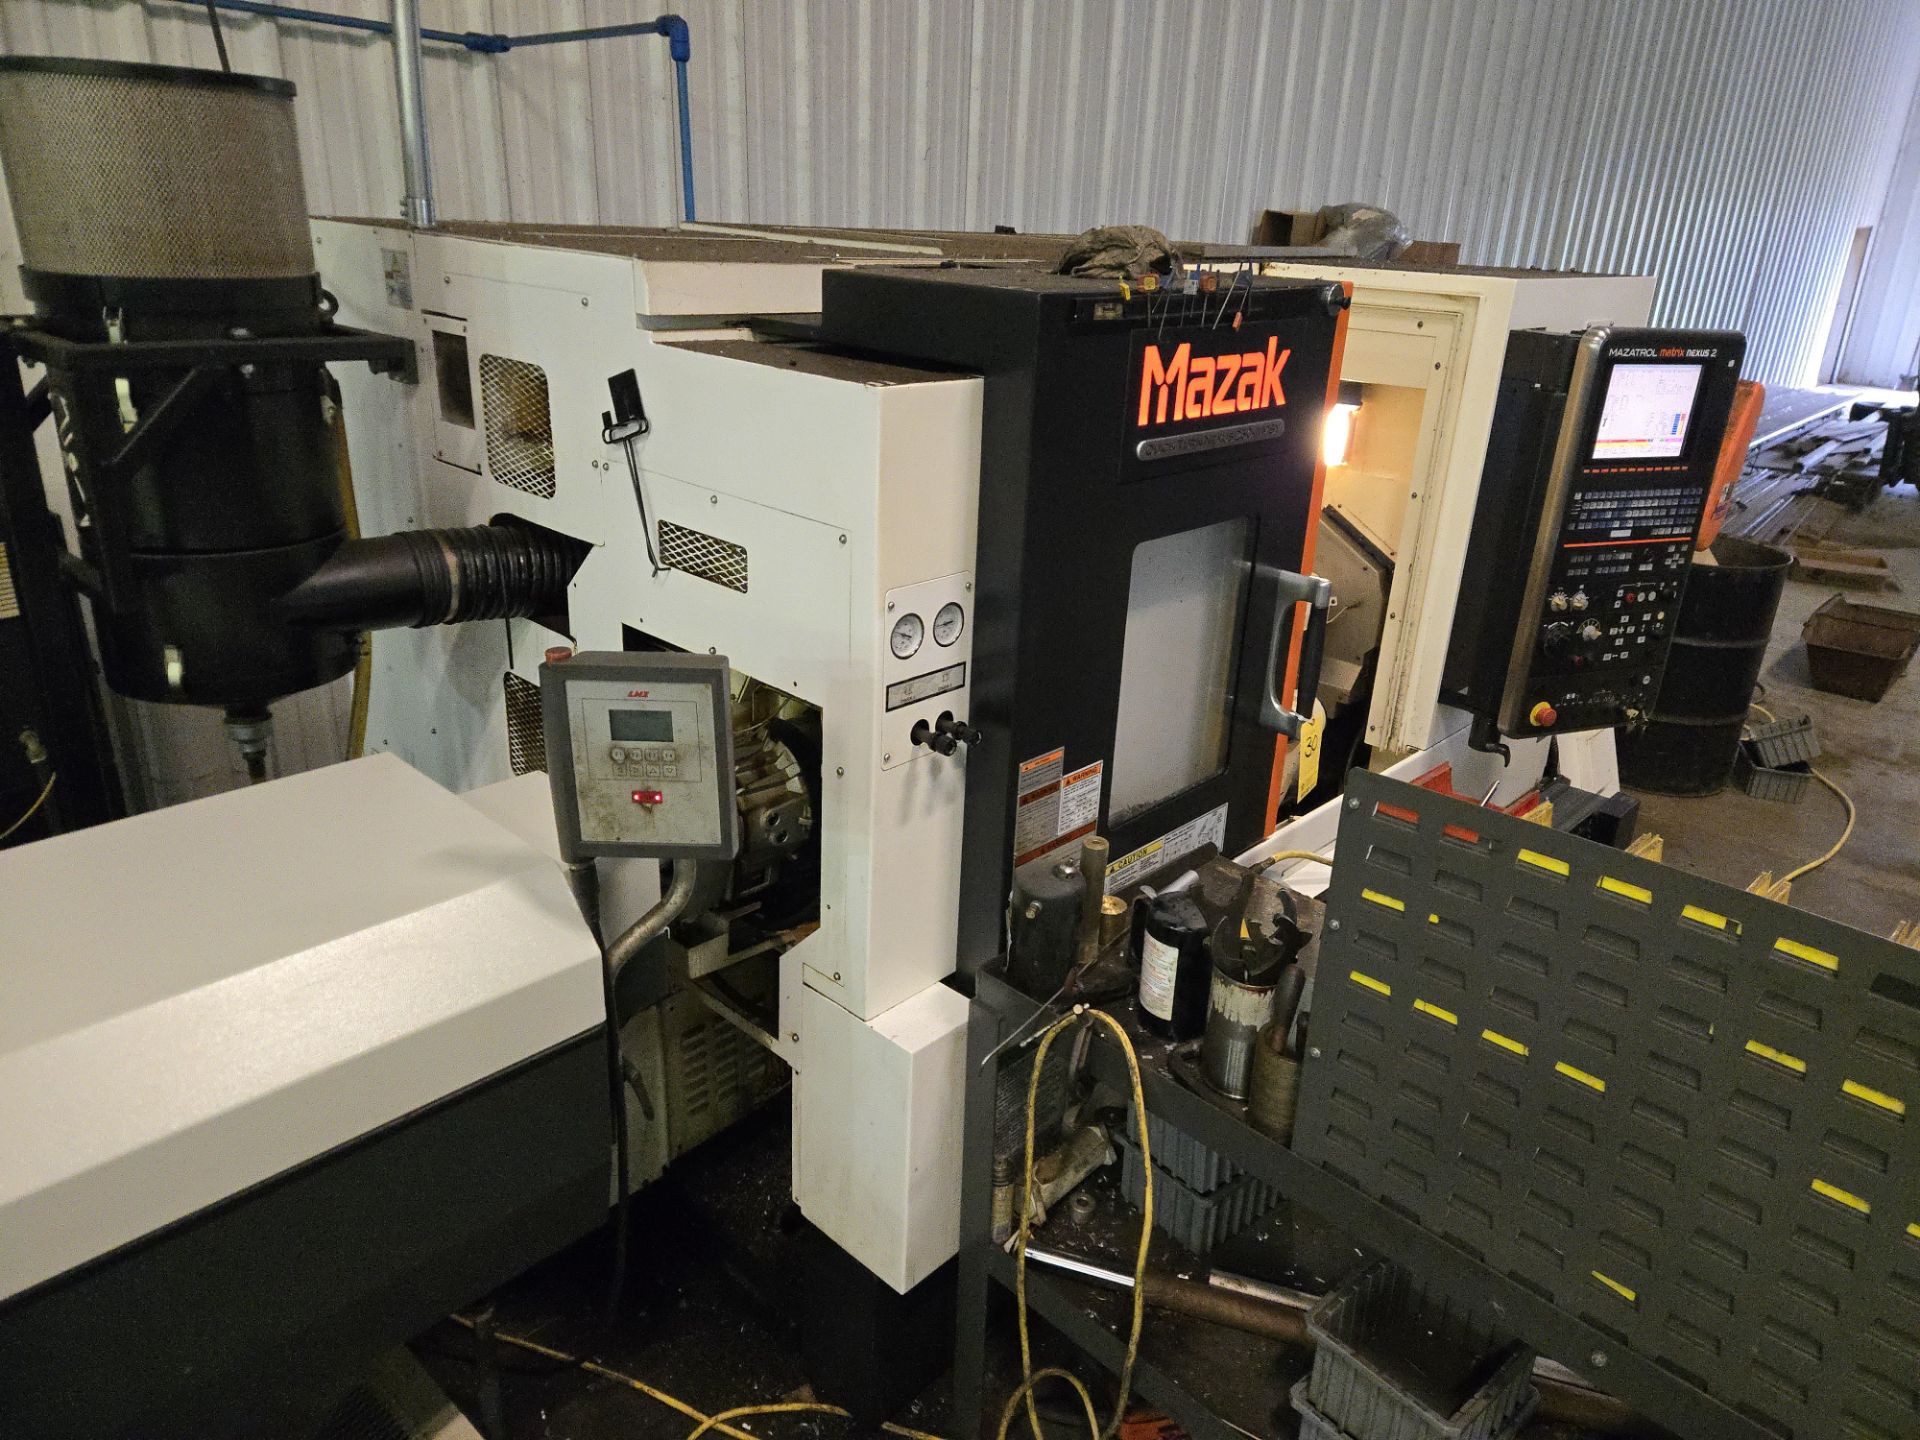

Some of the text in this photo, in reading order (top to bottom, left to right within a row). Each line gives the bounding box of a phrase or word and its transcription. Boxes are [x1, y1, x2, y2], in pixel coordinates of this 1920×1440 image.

[1608, 347, 1658, 358] MAZATROL
[1660, 347, 1685, 358] matrix
[1710, 348, 1718, 357] 2
[1137, 335, 1291, 428] Mazak
[1072, 766, 1098, 782] WARNING
[1118, 848, 1148, 869] CAUTION
